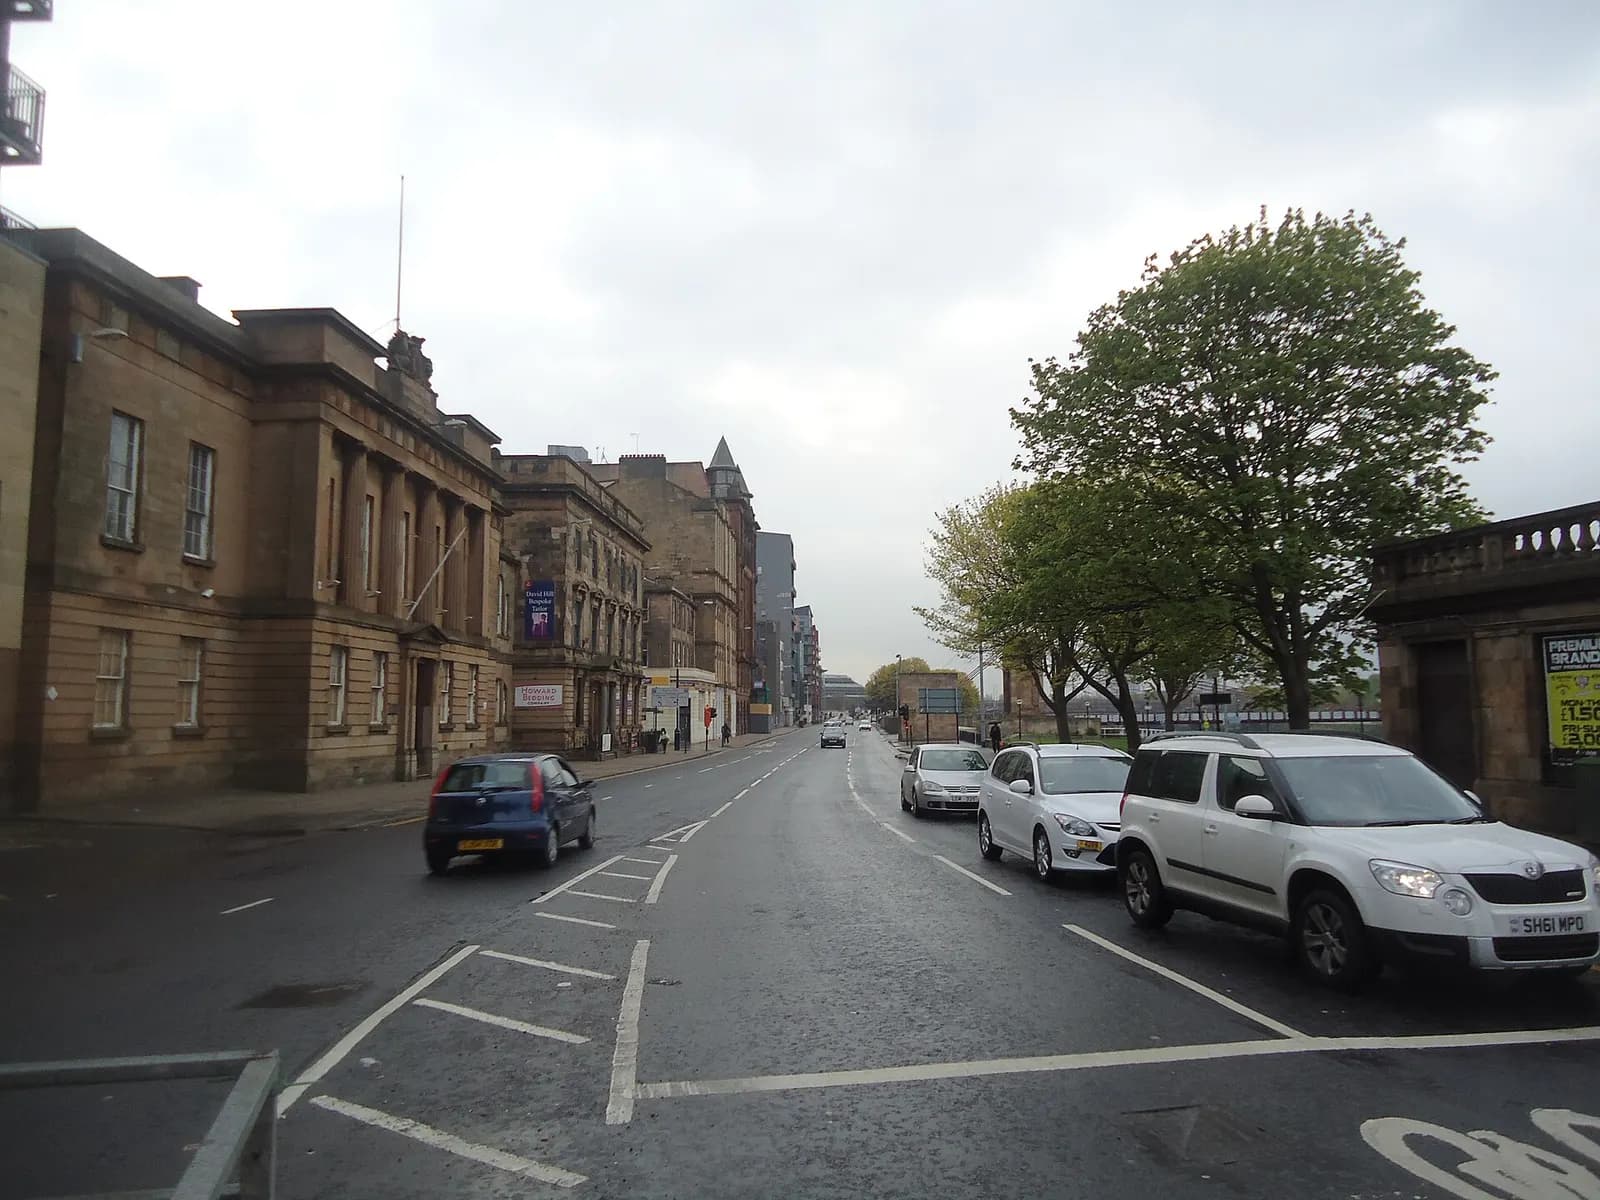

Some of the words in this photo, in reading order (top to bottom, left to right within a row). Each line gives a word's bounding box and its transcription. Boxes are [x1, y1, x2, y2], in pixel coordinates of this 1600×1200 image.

[1549, 638, 1600, 652] PREMIU
[1523, 918, 1556, 933] SH61
[1559, 916, 1584, 932] MPO
